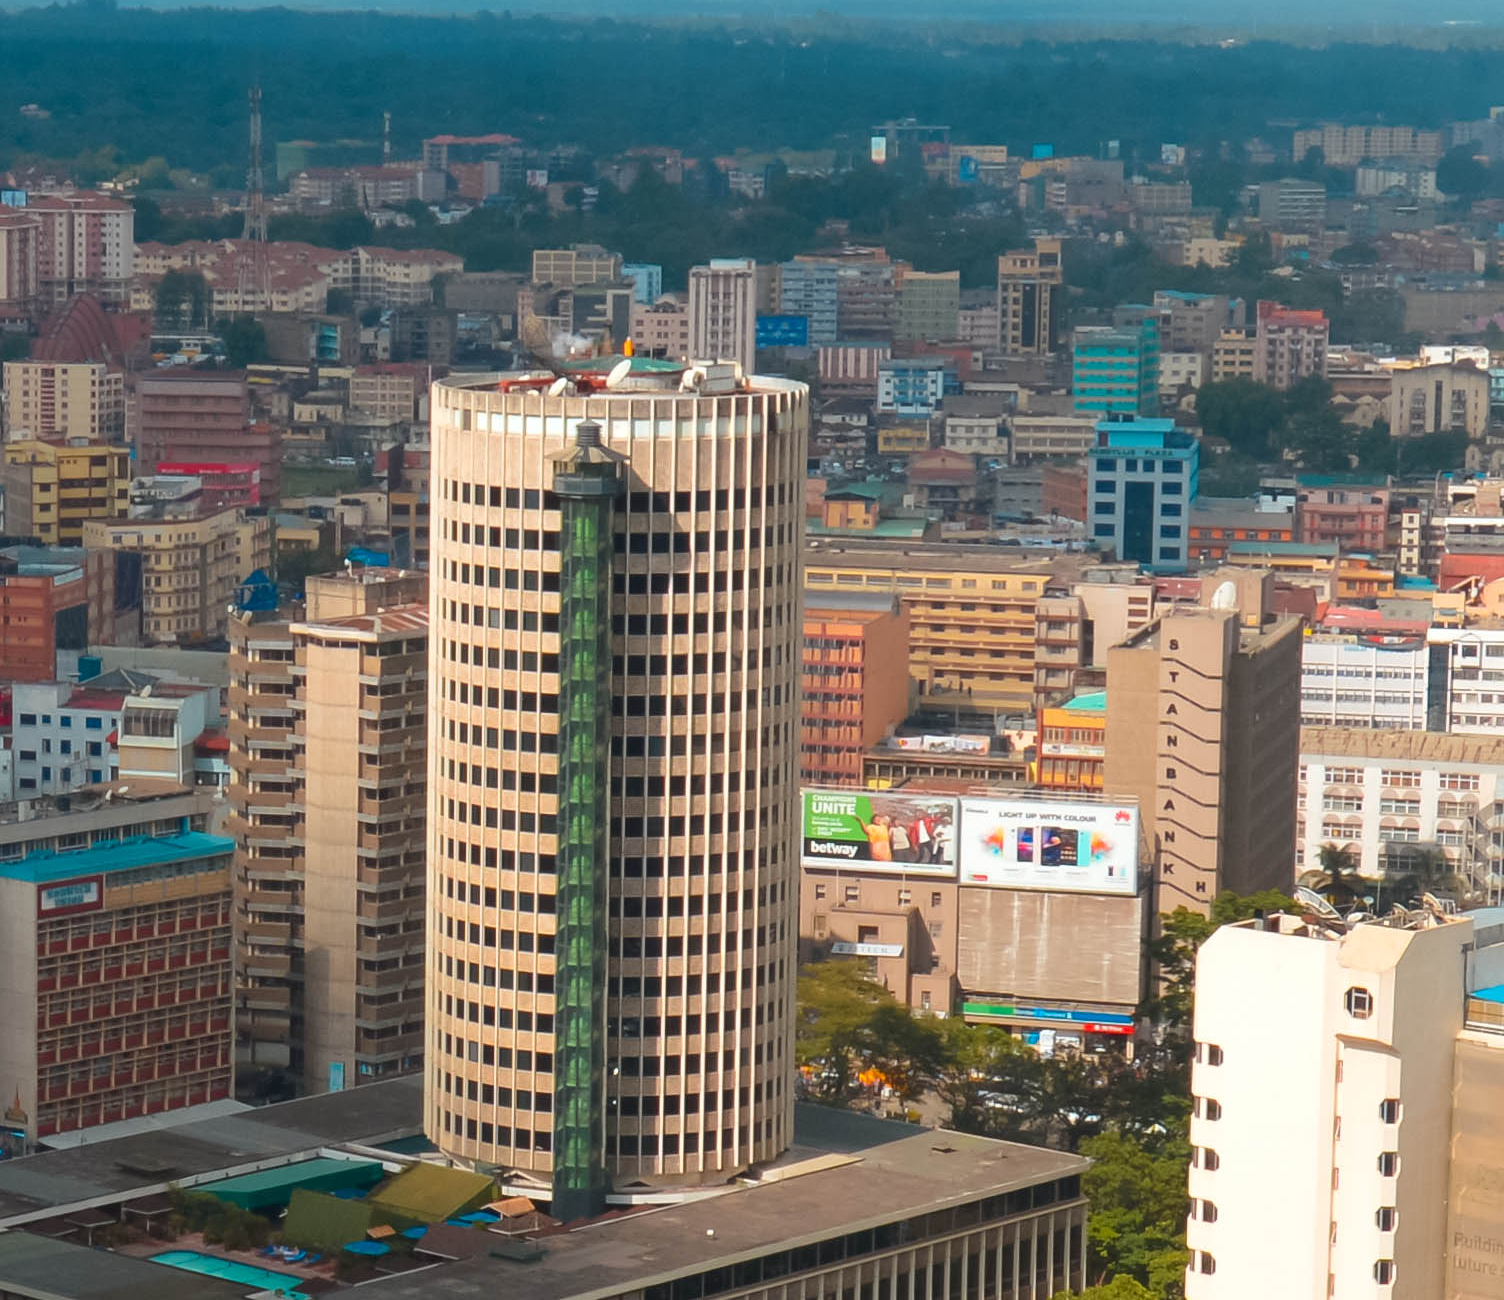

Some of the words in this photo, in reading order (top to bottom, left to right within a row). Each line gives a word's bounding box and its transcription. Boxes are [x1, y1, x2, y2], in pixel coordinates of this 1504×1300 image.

[811, 803, 857, 816] UNITE
[998, 811, 1023, 820] LIGHT
[1025, 812, 1038, 820] UP
[1039, 813, 1062, 822] WITH
[1064, 814, 1097, 824] COLOUR
[810, 840, 858, 858] betway
